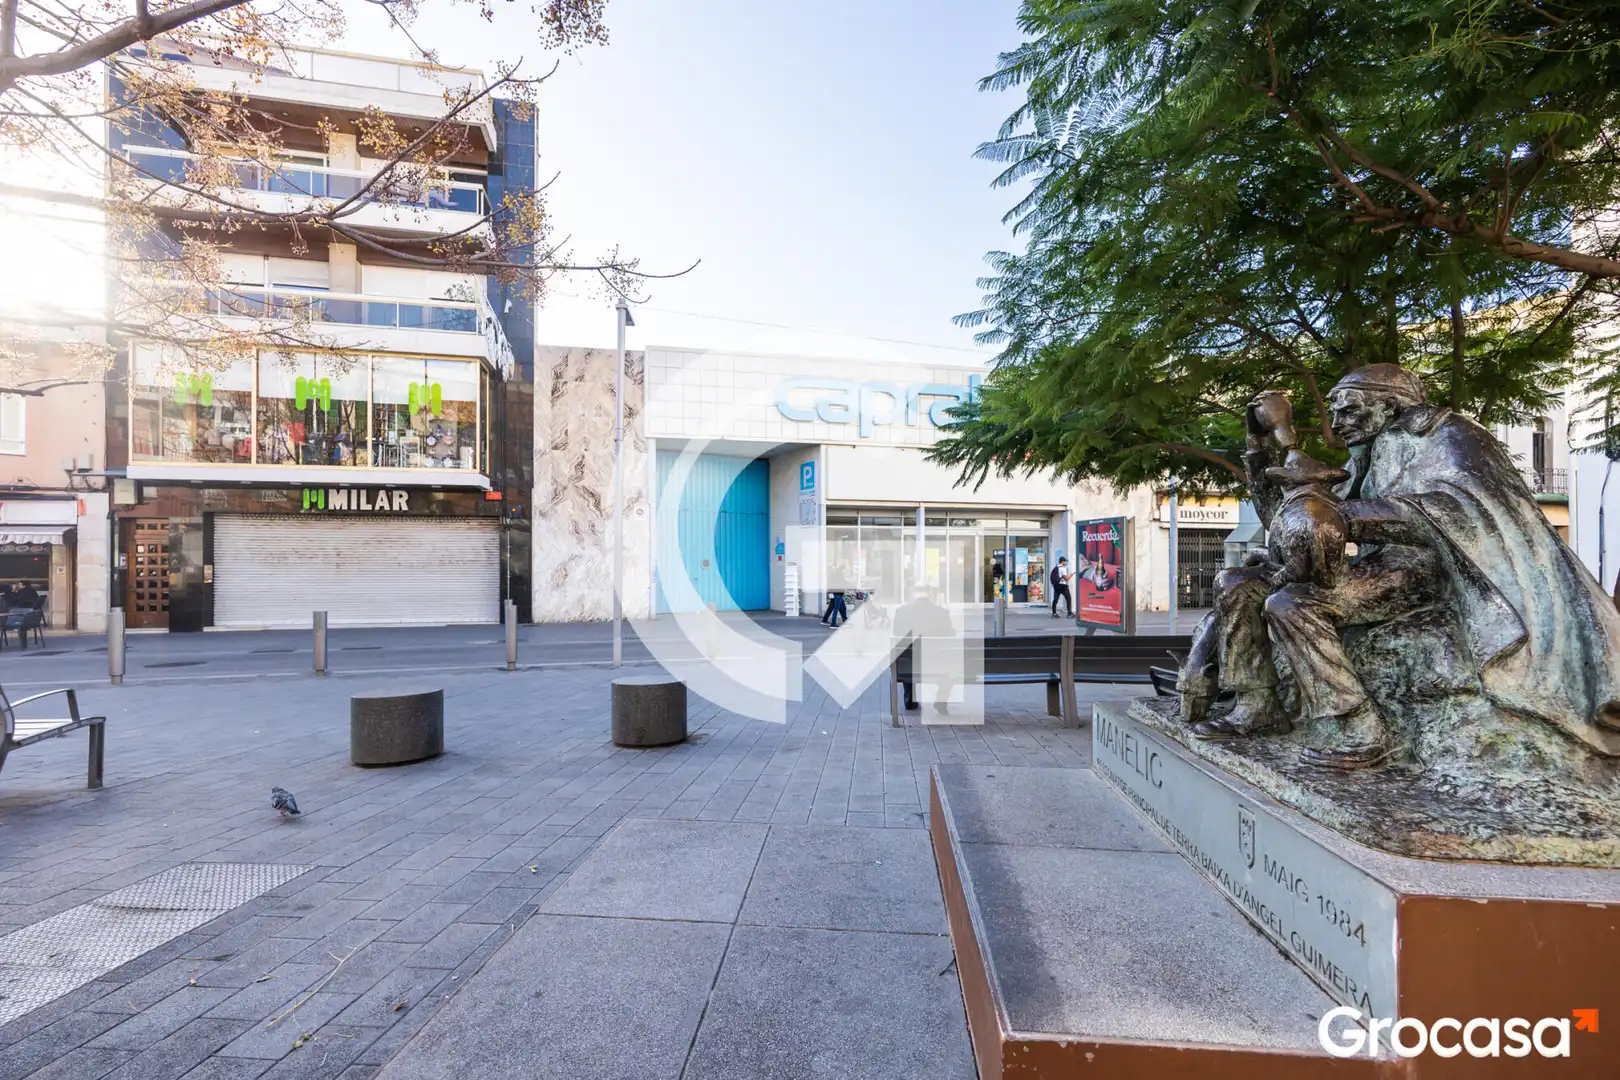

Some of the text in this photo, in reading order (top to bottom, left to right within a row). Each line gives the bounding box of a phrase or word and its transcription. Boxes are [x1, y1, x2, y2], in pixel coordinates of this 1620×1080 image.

[776, 374, 984, 438] capra
[328, 488, 409, 511] MILAR
[803, 465, 812, 488] P
[1180, 509, 1228, 521] moycor
[1096, 712, 1163, 789] MANELIC
[1172, 824, 1200, 862] TERRA
[1201, 851, 1231, 891] BAIXA
[1263, 853, 1367, 948] MAIG 1984
